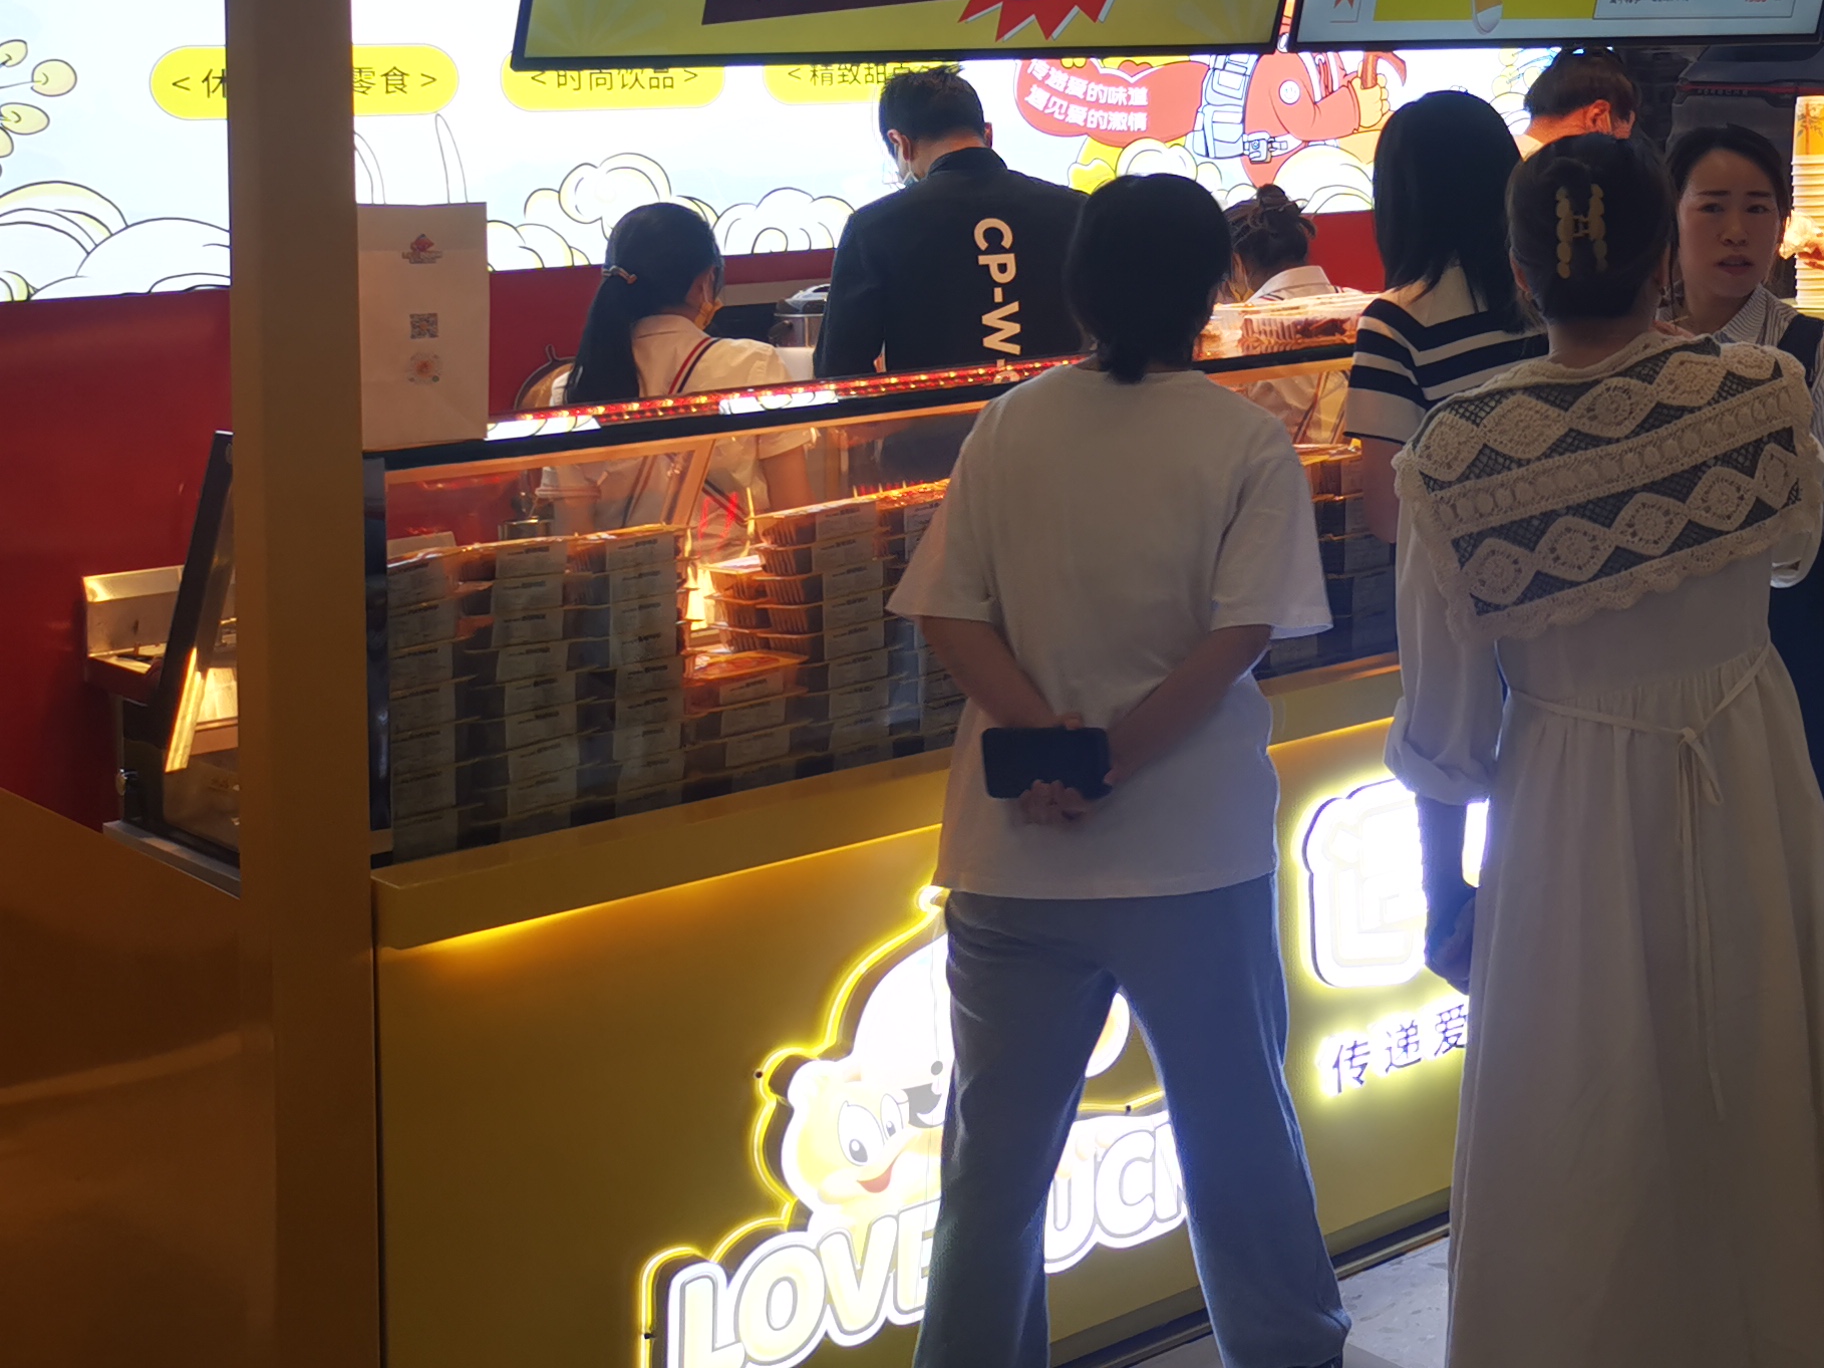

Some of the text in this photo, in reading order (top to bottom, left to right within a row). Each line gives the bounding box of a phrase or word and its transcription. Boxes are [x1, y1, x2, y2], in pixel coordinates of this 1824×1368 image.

[1026, 58, 1149, 107] 传递爱的味道
[1024, 87, 1148, 133] 遇见爱的激情
[1331, 999, 1469, 1094] 传递爱
